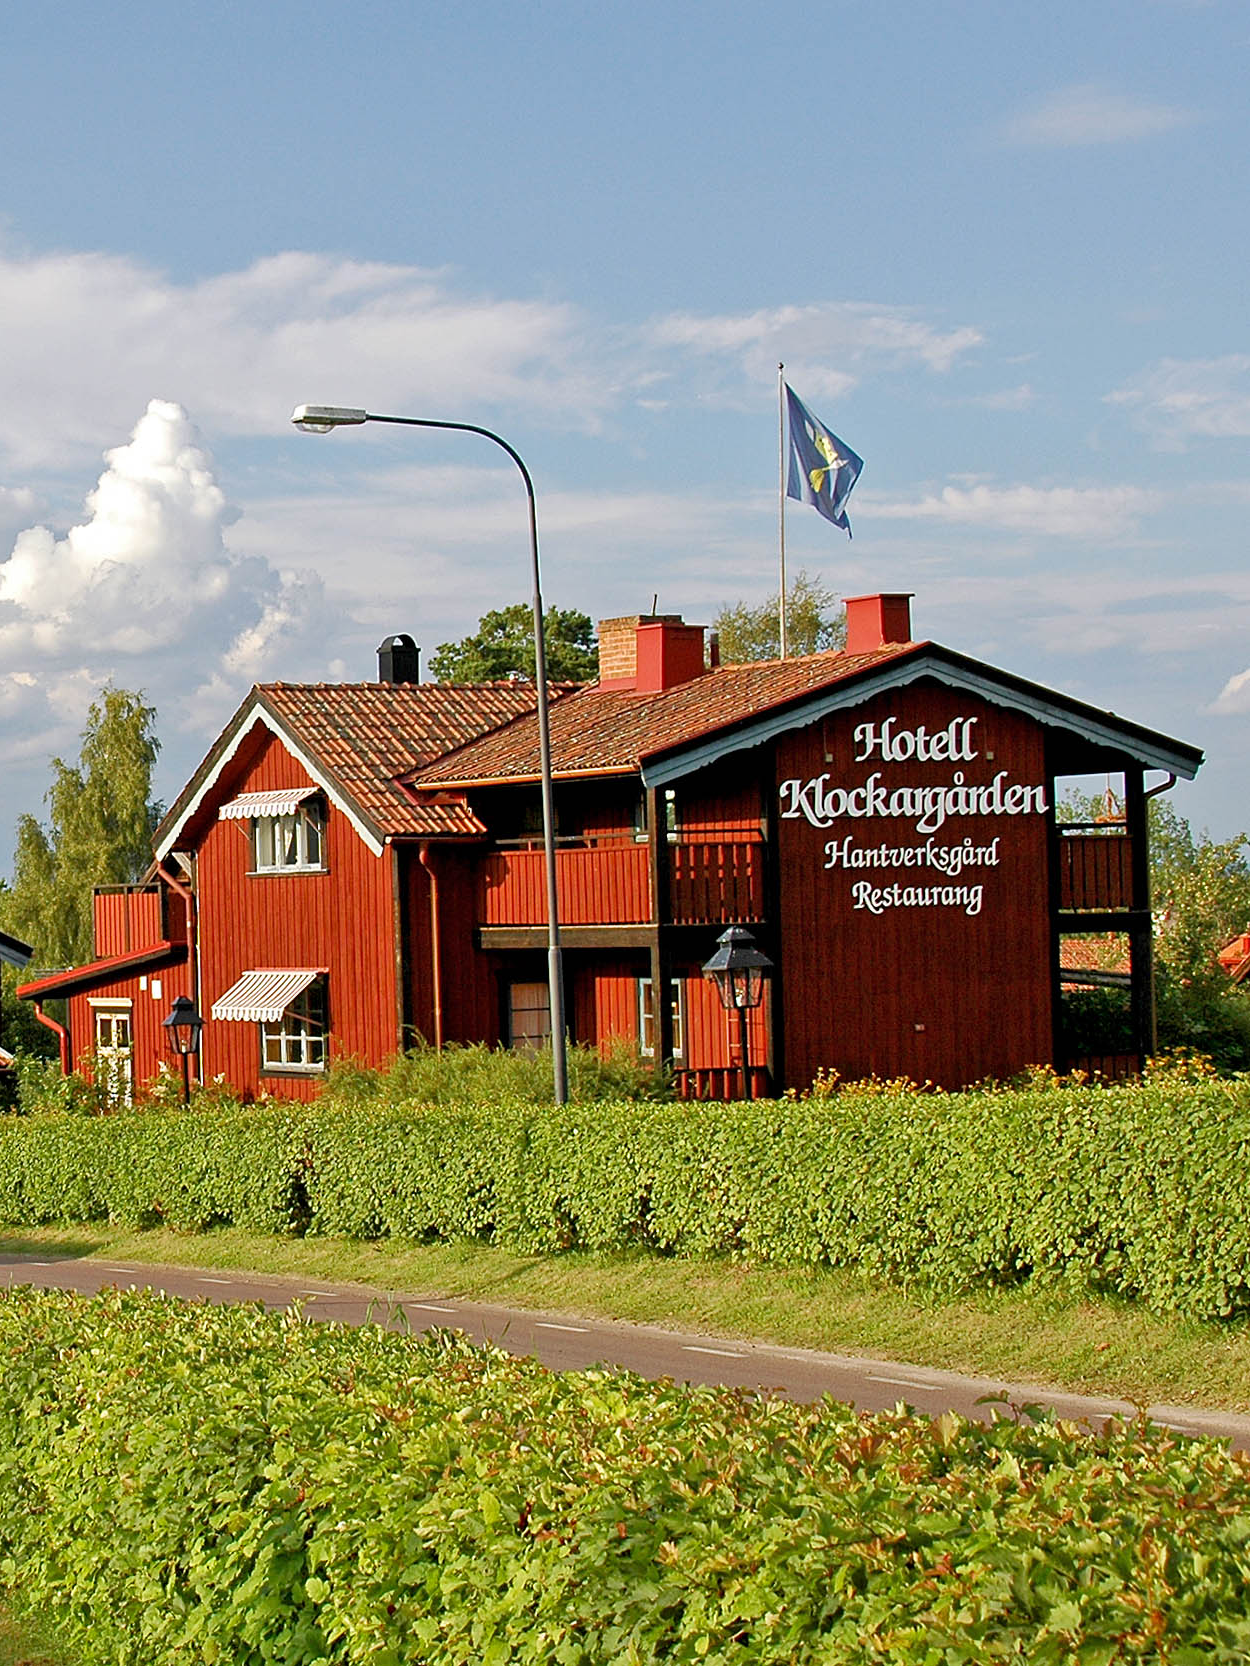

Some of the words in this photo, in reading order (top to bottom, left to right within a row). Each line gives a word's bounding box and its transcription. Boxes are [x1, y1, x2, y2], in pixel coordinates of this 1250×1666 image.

[853, 716, 978, 762] Hotell
[779, 771, 1049, 833] Klockargården
[824, 836, 1000, 876] Hantverksgård
[852, 881, 983, 915] Restaurang
